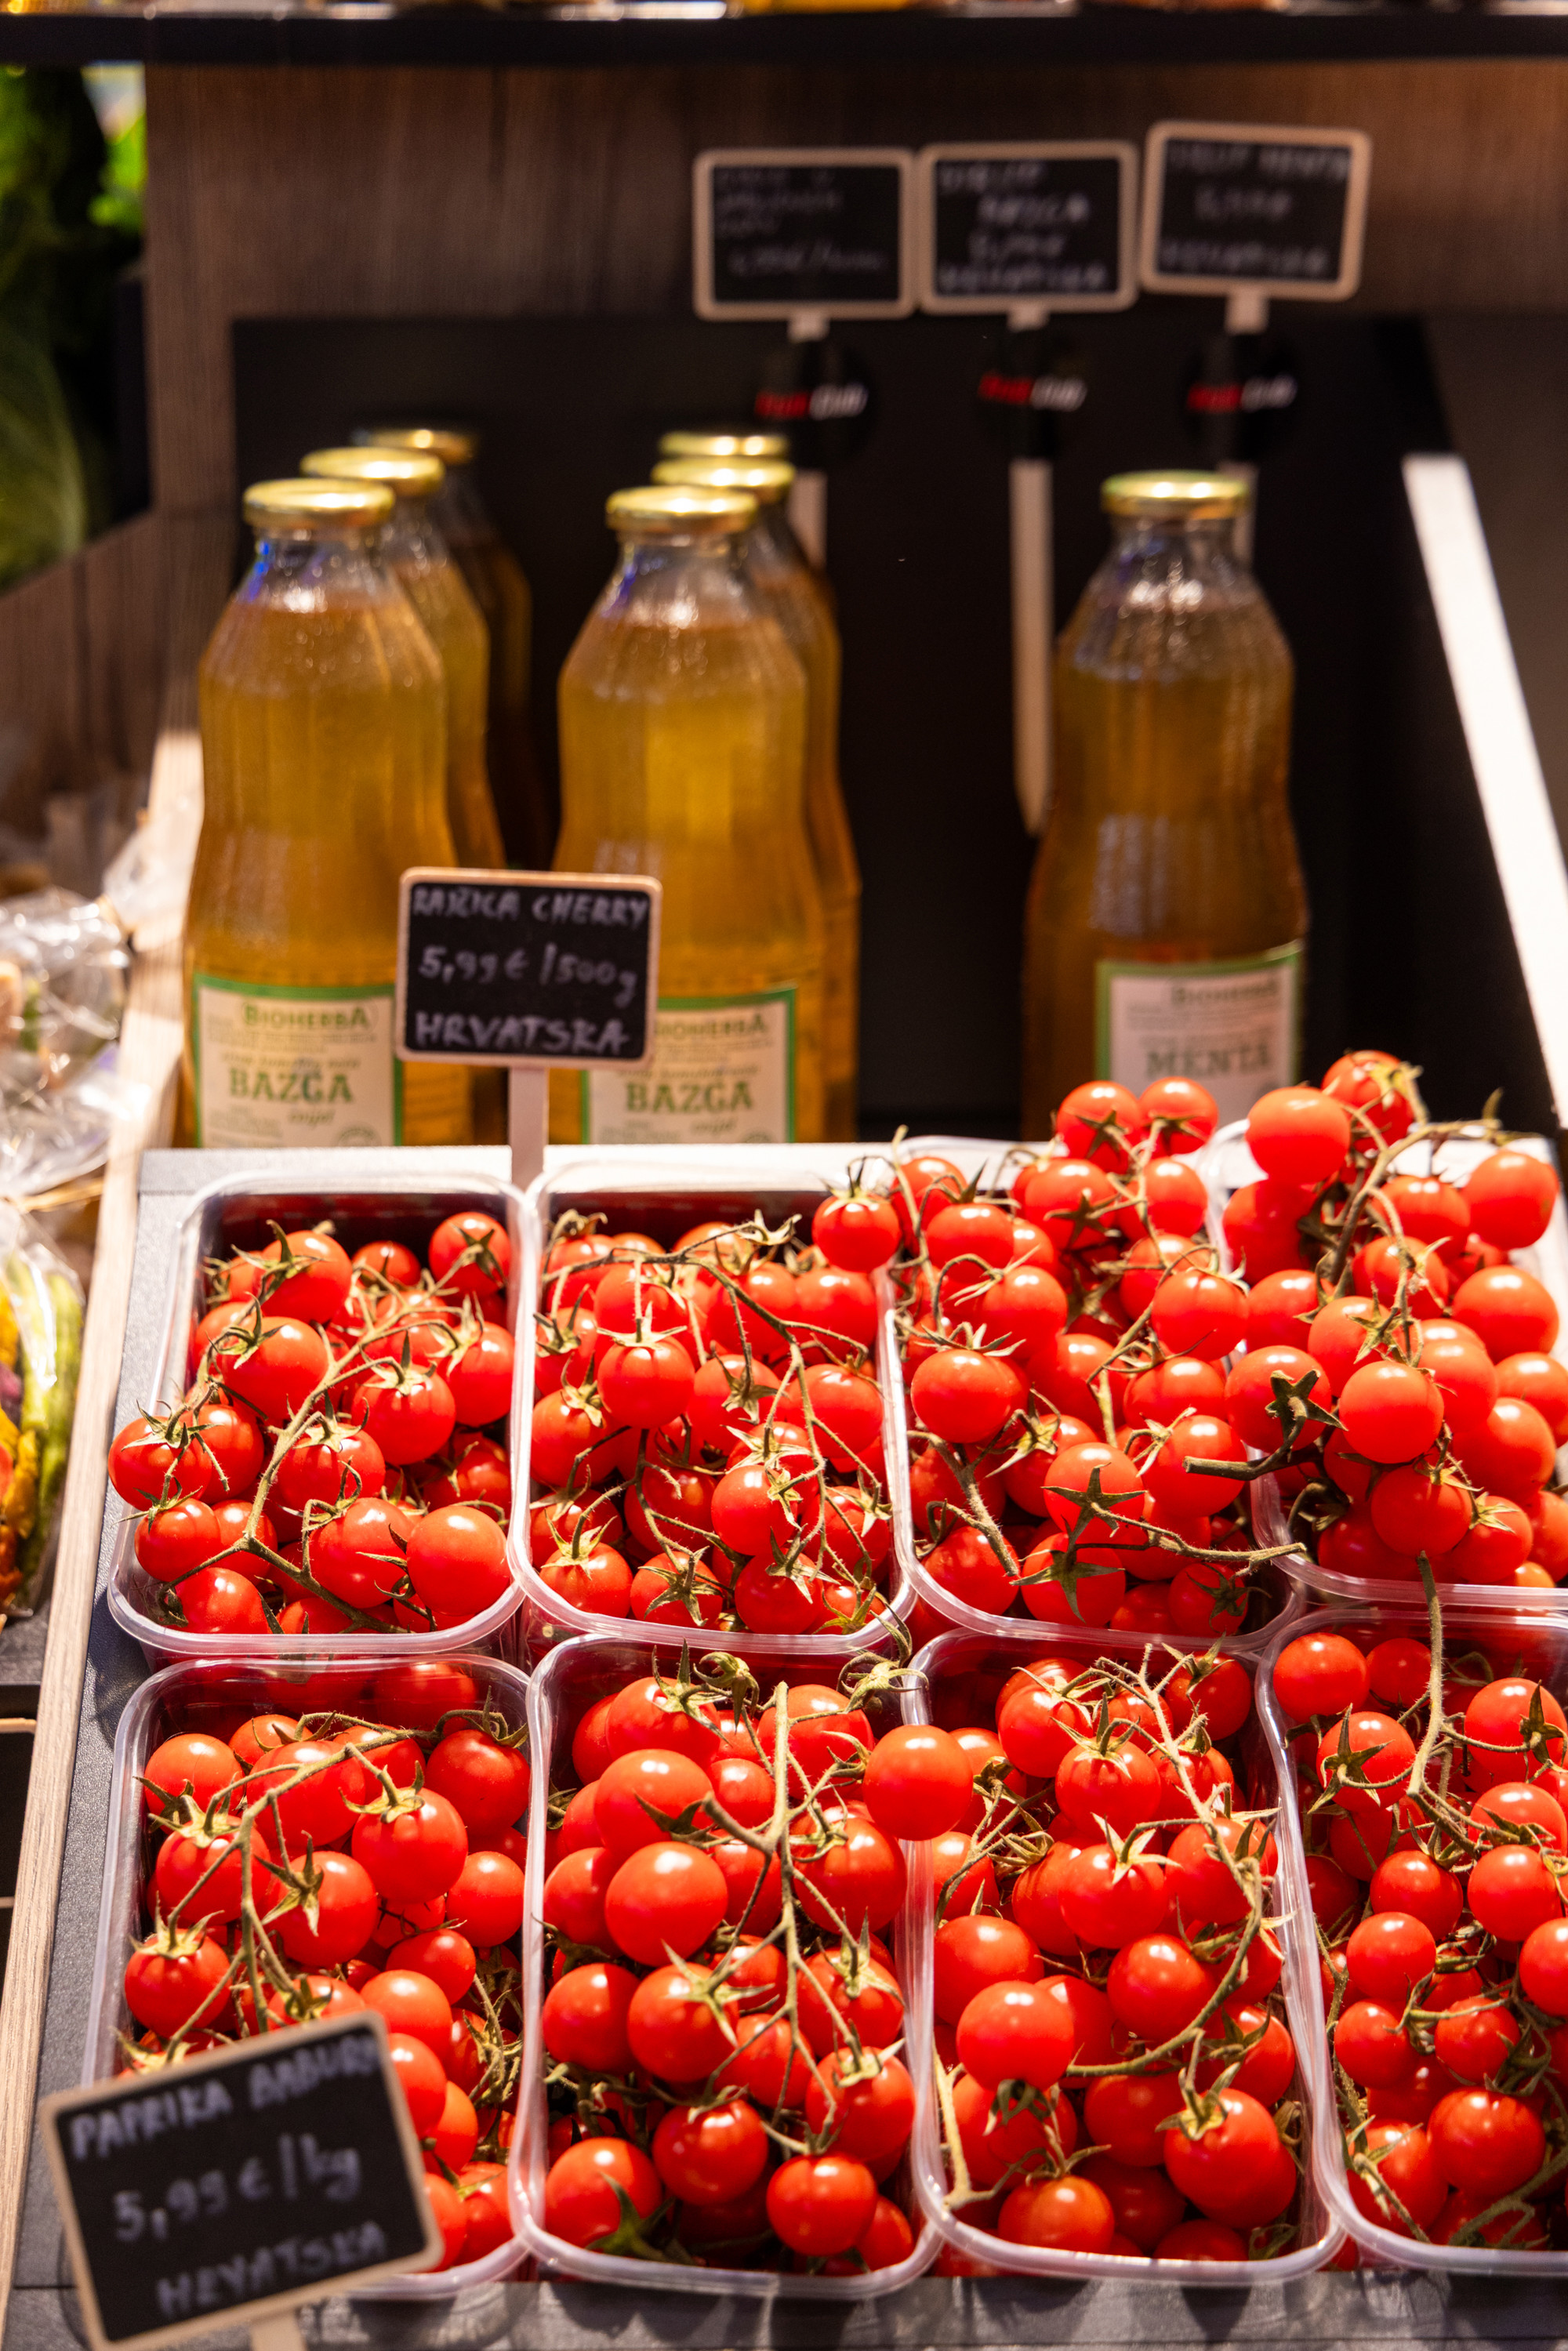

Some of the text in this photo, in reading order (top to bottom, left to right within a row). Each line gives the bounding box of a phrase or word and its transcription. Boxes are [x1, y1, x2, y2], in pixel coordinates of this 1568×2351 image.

[532, 891, 648, 928] CHERRY
[245, 1003, 369, 1028] BIOHERBA
[415, 1010, 630, 1055] HRVATSKA
[229, 1067, 354, 1102] BAZGA
[626, 1080, 753, 1114] BAZGA
[71, 2079, 234, 2161] PAPRIKA
[158, 2220, 387, 2318] HRVATSKA
